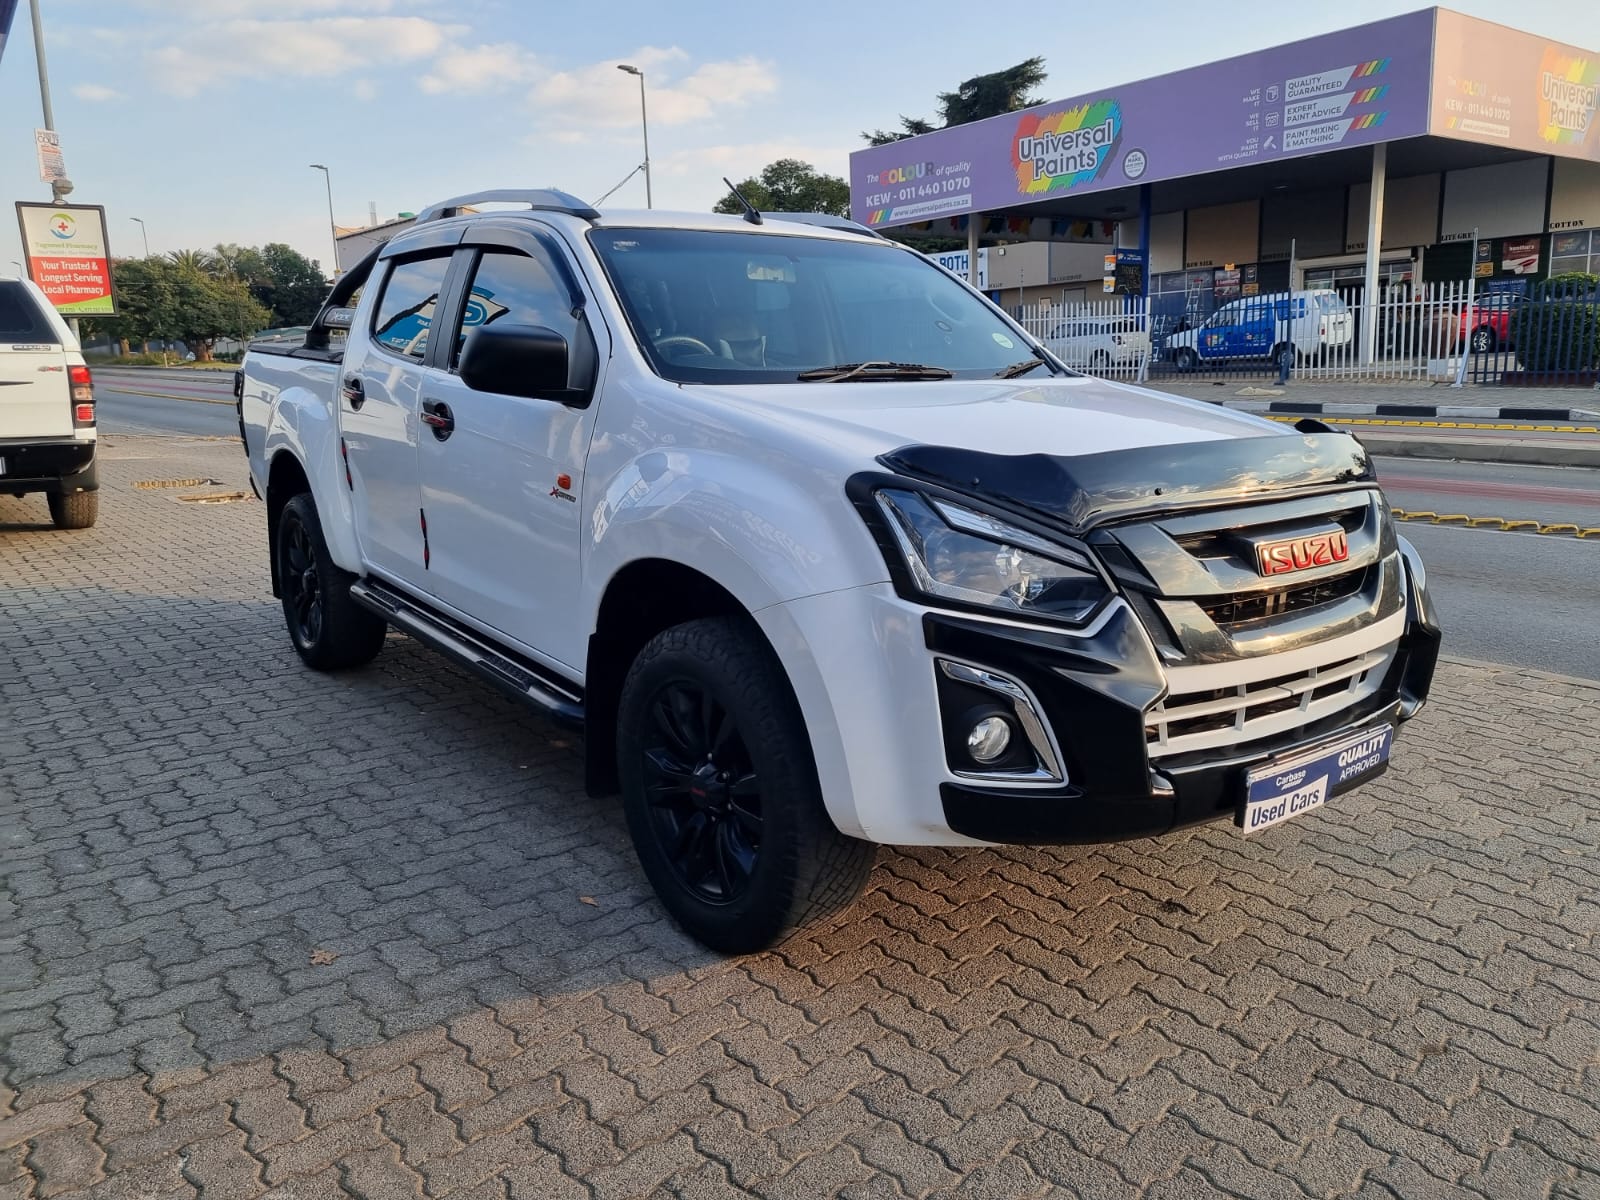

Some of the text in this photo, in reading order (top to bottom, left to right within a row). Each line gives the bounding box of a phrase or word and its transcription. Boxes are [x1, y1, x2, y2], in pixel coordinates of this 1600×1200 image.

[1288, 77, 1321, 90] QUALITY
[1288, 81, 1342, 98] GUARANTEED
[1543, 72, 1596, 110] Universal
[1287, 103, 1317, 115] EXPERT
[1445, 98, 1463, 112] KEW
[1287, 106, 1342, 123] PAINT ADVICE
[1550, 104, 1587, 130] Paints
[1286, 124, 1340, 140] PAINT MIXING
[1292, 133, 1334, 147] MATCHING
[1019, 122, 1113, 160] Universal
[1233, 150, 1258, 160] QUALITY
[1034, 151, 1097, 178] Paints
[866, 160, 971, 187] The COLOUR of quality
[866, 192, 891, 208] KEW
[899, 186, 916, 201] 011
[918, 182, 940, 197] 440
[942, 176, 970, 192] 1070
[894, 199, 969, 217] www.universalpaints.co.za
[1550, 219, 1584, 229] COTTON
[1457, 231, 1475, 240] GRE
[41, 260, 98, 271] Your Trusted &
[40, 272, 103, 284] Longest Serving
[42, 285, 104, 296] Local Pharmacy
[1261, 533, 1349, 575] ISUZU
[1337, 733, 1386, 768] QUALITY
[1339, 753, 1380, 781] APPROVED
[1276, 769, 1307, 787] Carbase
[1251, 788, 1320, 828] Used Cars
